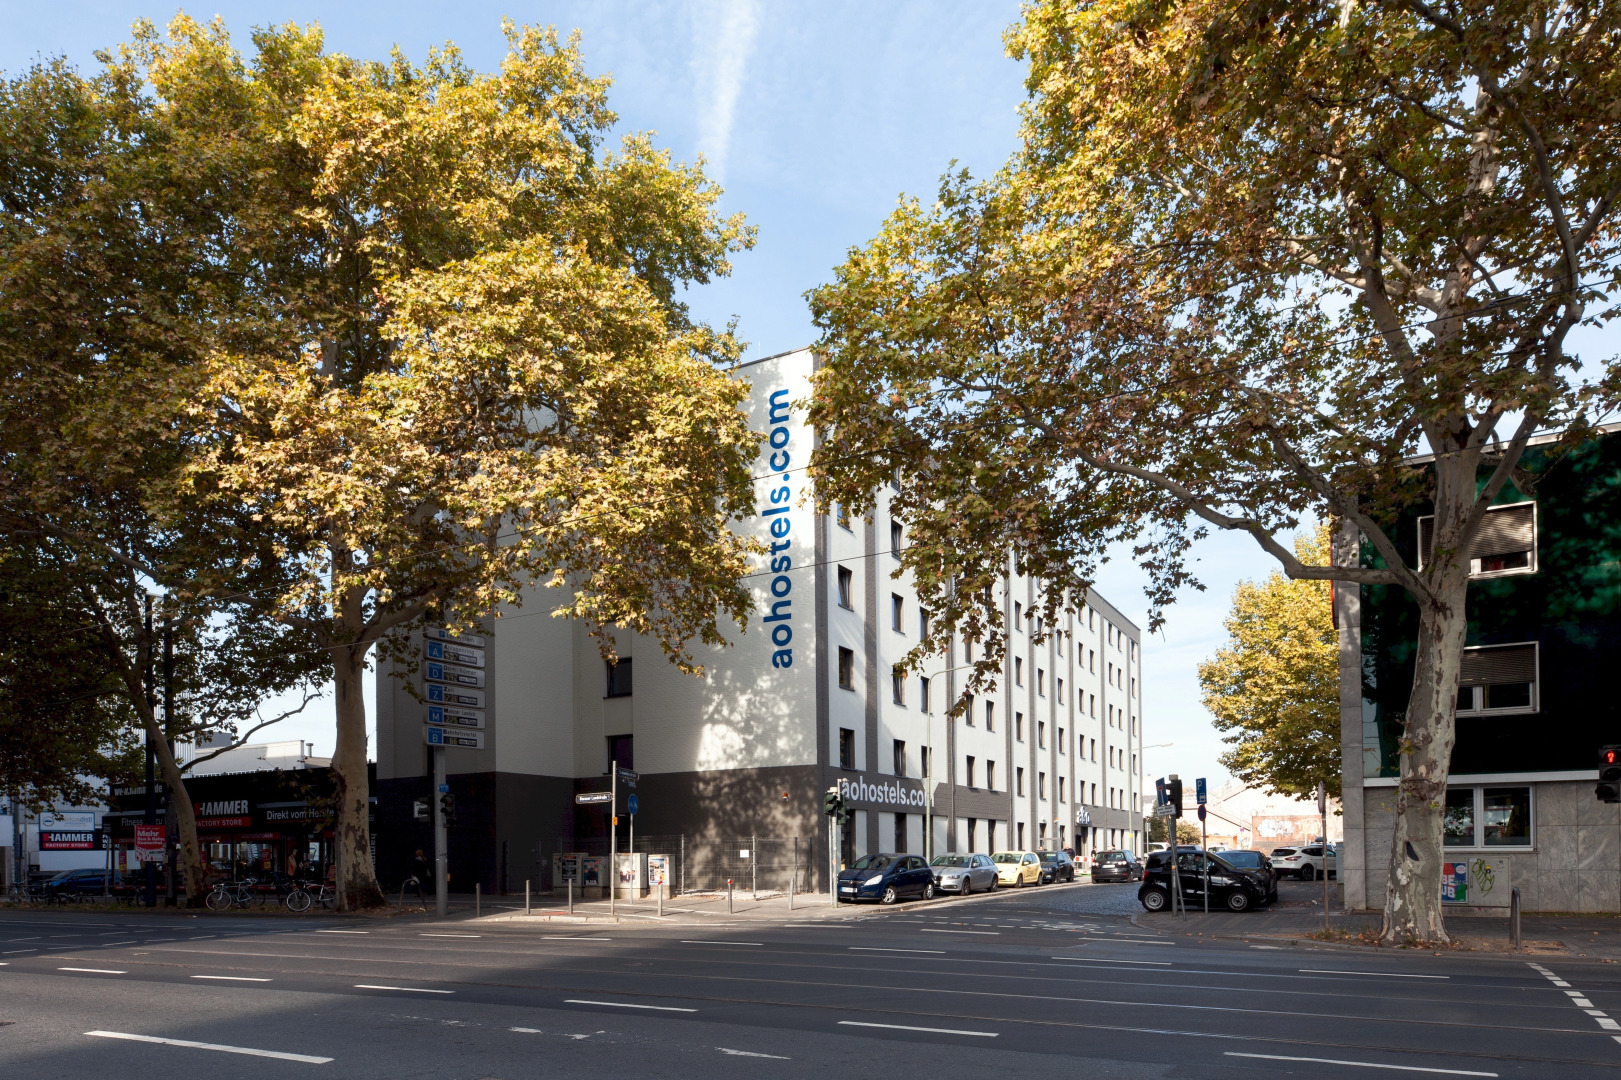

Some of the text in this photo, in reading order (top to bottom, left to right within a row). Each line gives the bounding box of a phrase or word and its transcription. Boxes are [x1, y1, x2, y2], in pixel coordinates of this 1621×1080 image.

[761, 388, 793, 669] aohostels.com
[432, 648, 439, 656] A
[432, 669, 438, 678] D
[433, 690, 439, 699] Z
[432, 712, 439, 721] M
[432, 734, 438, 742] B
[1197, 780, 1202, 790] P
[194, 800, 248, 816] HAMMER
[266, 810, 289, 820] Direkt
[290, 810, 306, 819] vom
[122, 818, 144, 826] Fitness
[43, 833, 93, 841] HAMMER
